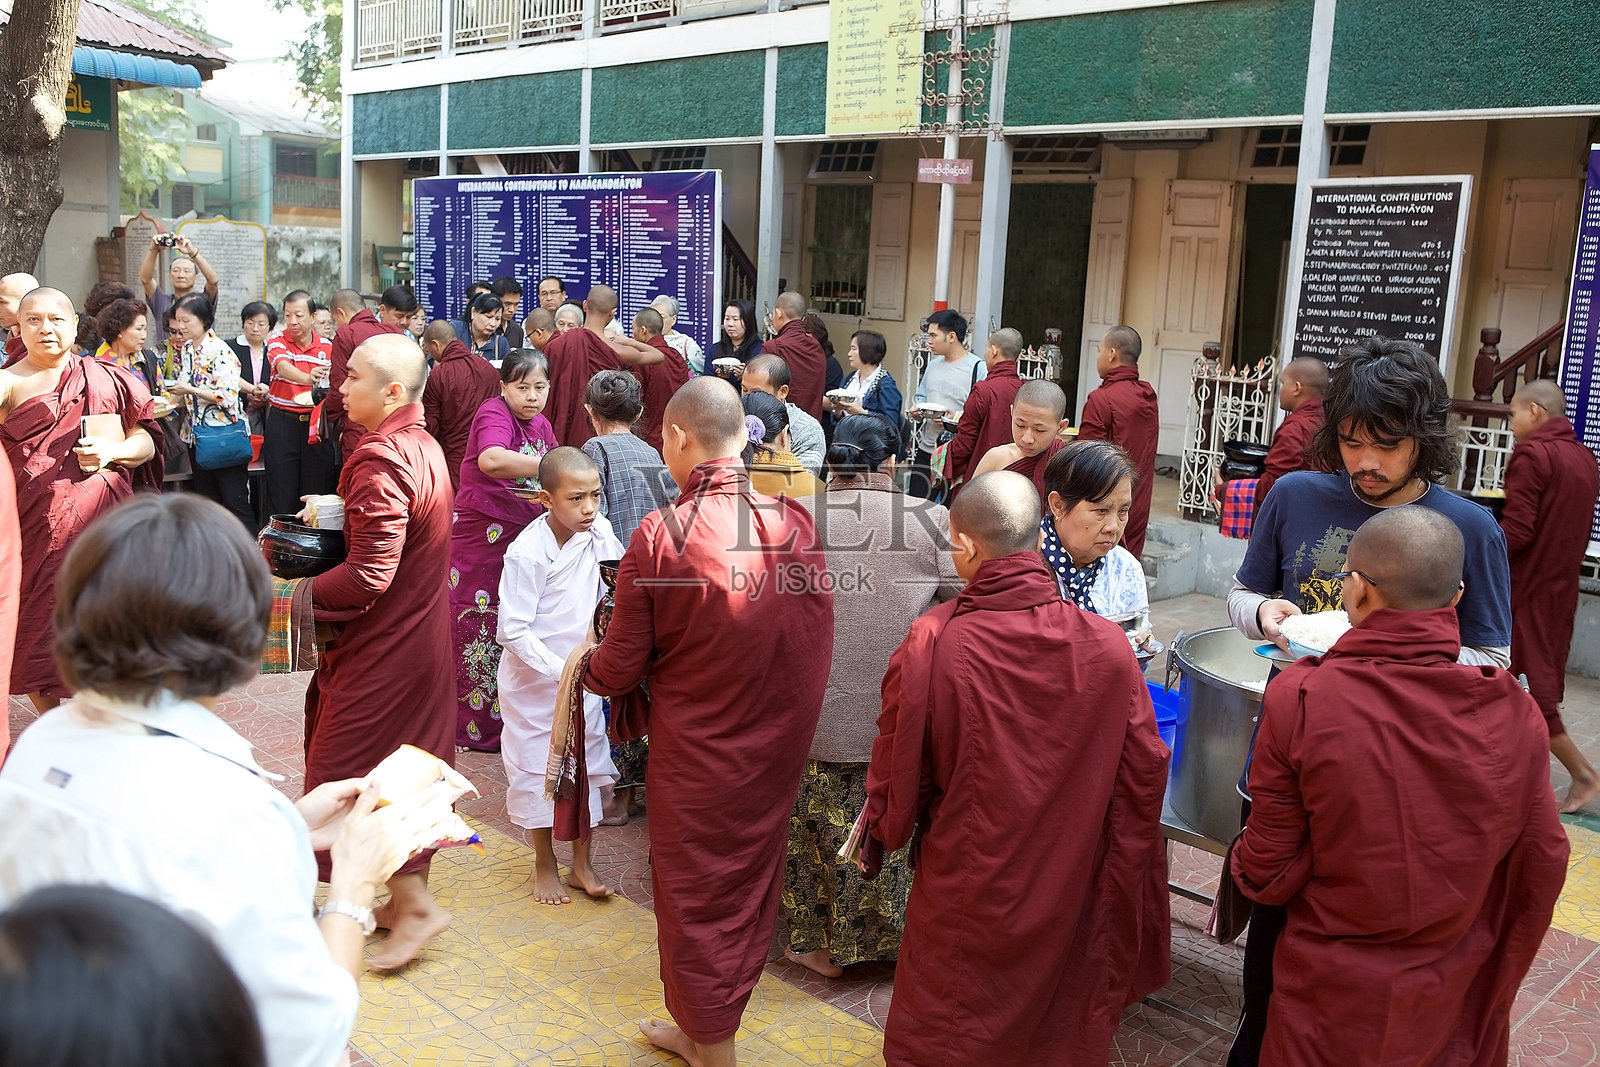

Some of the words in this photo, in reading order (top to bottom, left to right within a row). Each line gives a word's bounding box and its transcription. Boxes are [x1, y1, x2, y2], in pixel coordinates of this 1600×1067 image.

[458, 181, 502, 192] INTERNATIONAL
[505, 180, 557, 191] CONTRIBUTIONS
[558, 179, 567, 190] TO
[1316, 194, 1377, 203] INTERNATIONAL
[1380, 192, 1454, 201] CONTRIBUTIONS
[1336, 205, 1346, 214] TO
